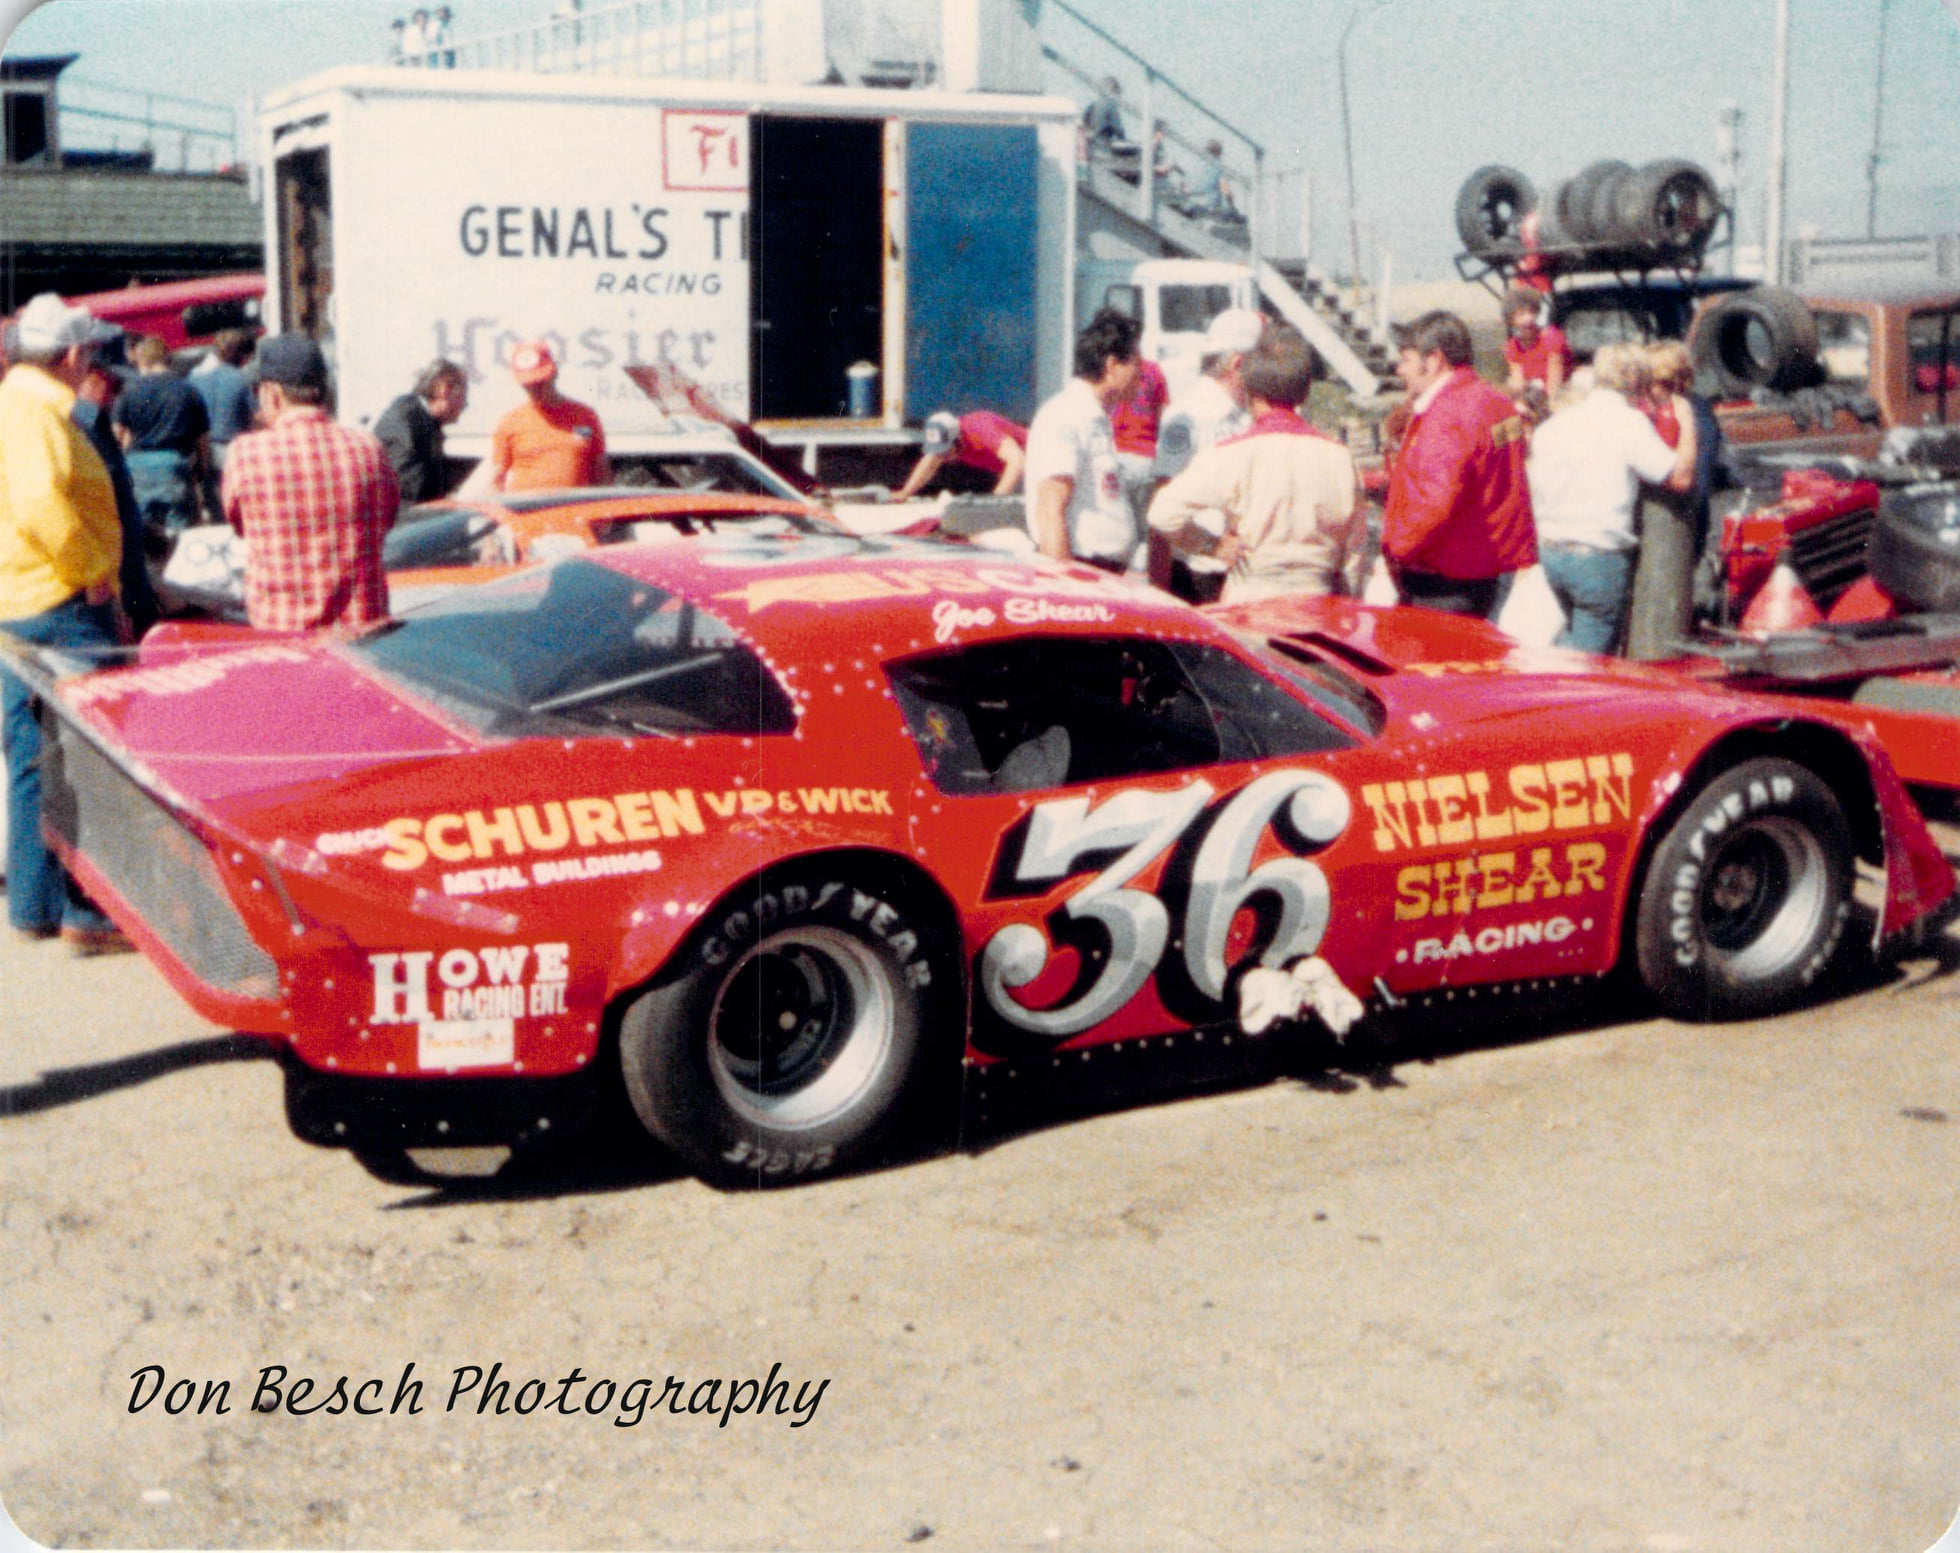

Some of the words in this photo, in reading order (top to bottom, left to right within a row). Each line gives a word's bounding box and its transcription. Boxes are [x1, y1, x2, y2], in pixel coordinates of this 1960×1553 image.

[460, 203, 669, 260] GENAL'S
[595, 272, 722, 295] RACING
[931, 599, 996, 643] Joe
[1003, 597, 1116, 624] Shear
[777, 790, 798, 814] &
[797, 787, 894, 816] WICK
[1361, 752, 1634, 853] NIELSEN
[381, 788, 706, 870] SCHUREN
[441, 864, 529, 896] METAL
[532, 850, 662, 886] BUILDINGS
[1394, 843, 1608, 922] SHEAR
[981, 768, 1351, 1036] 36
[1413, 915, 1576, 966] RACING
[368, 942, 570, 1025] HOWE
[443, 984, 526, 1020] RACING
